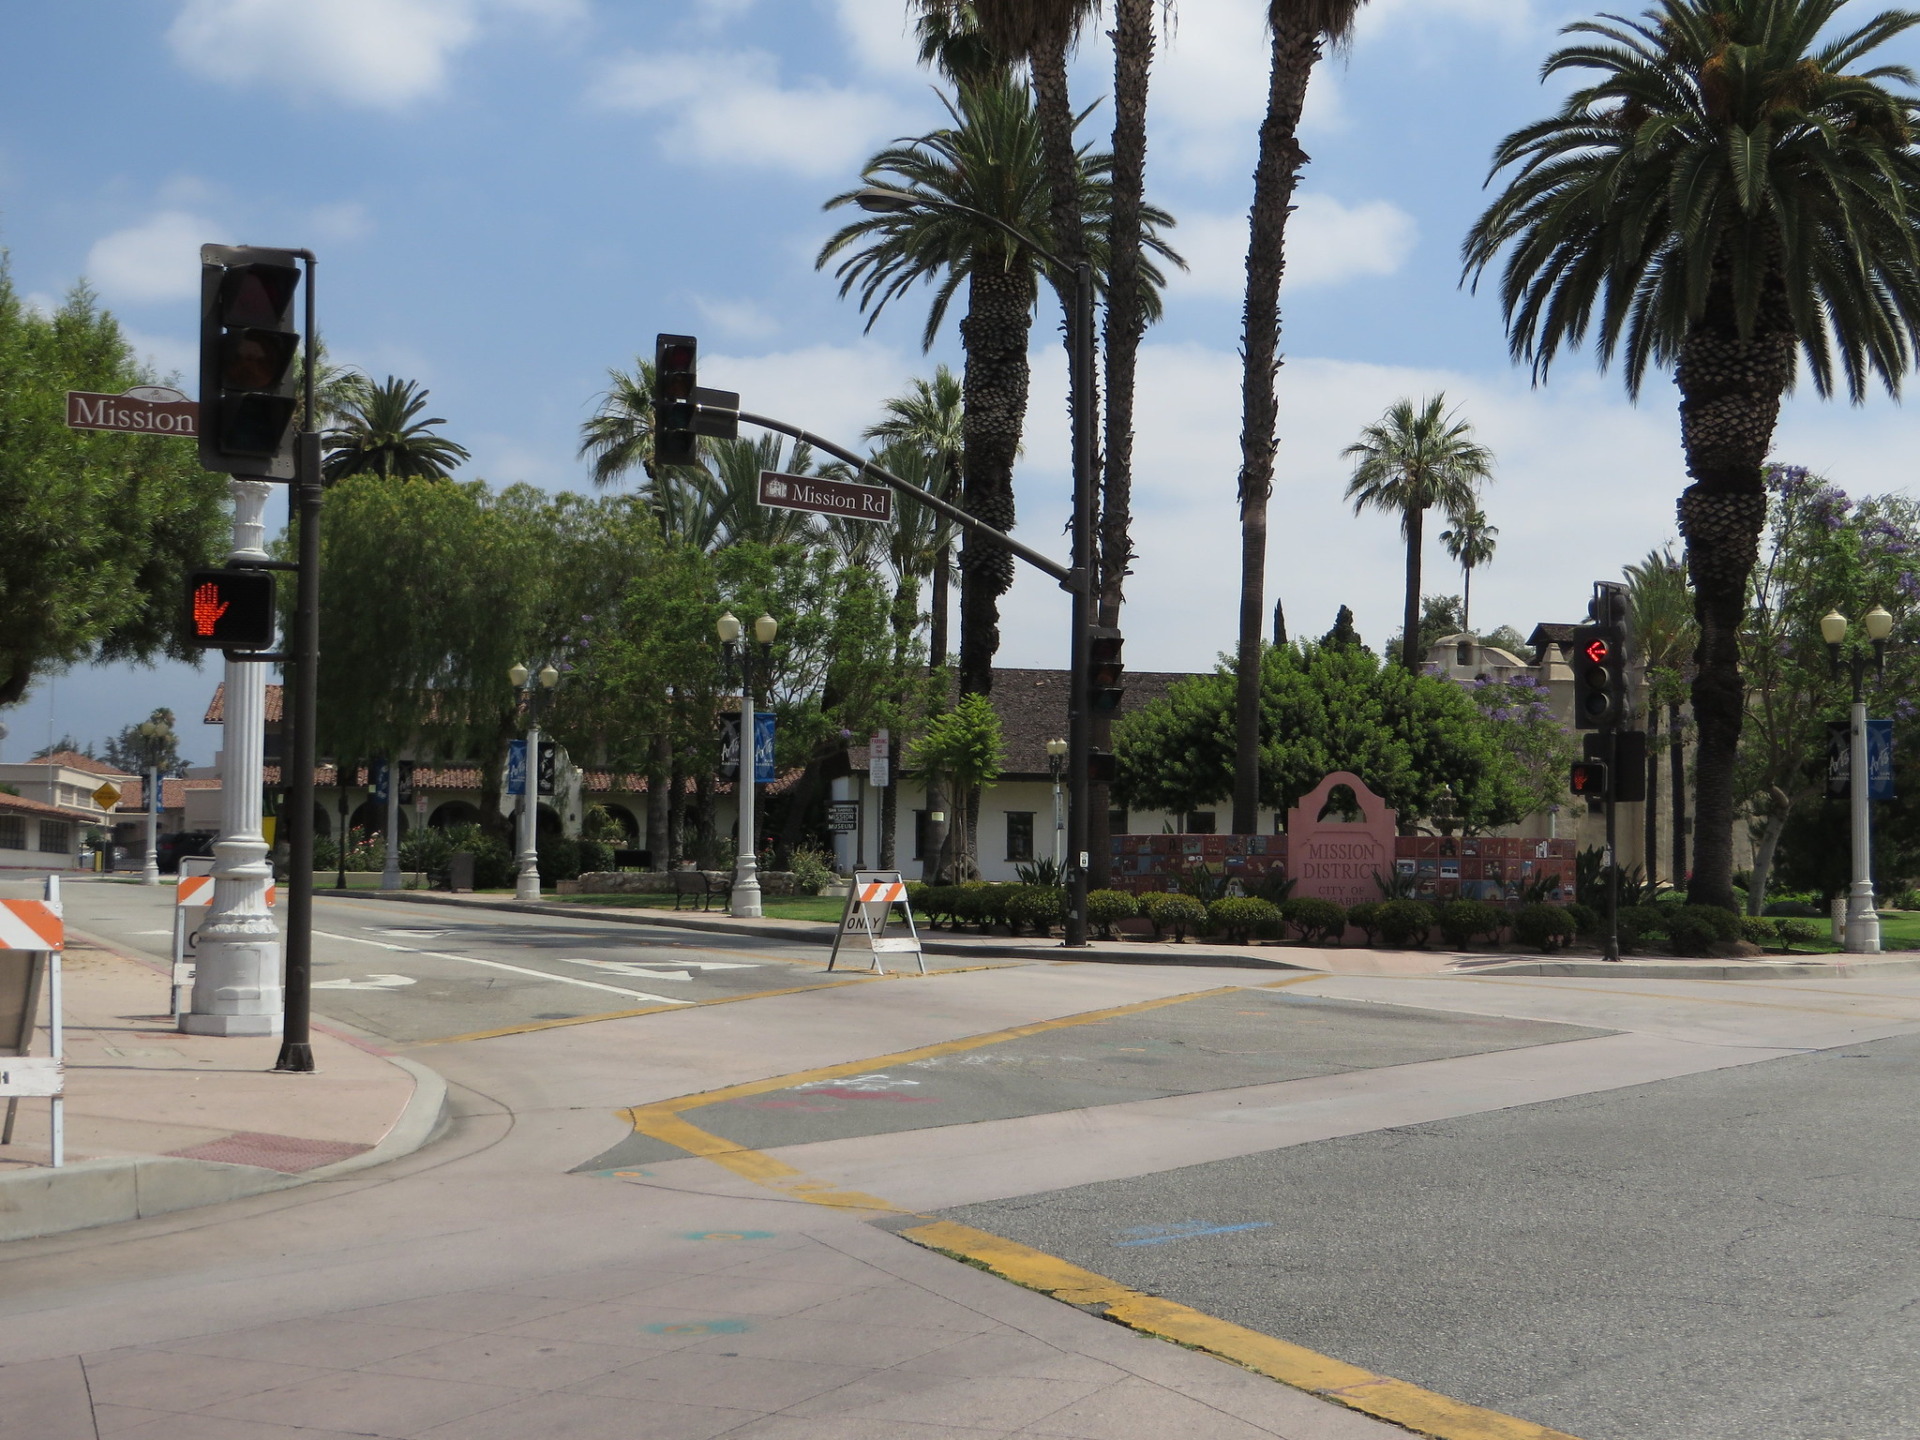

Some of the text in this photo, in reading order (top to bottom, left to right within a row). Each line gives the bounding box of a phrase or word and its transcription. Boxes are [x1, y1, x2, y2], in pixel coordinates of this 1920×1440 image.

[74, 397, 194, 432] Mission
[792, 483, 885, 513] Mission Rd
[1309, 844, 1375, 860] MISSION
[1303, 863, 1381, 879] DISTRICT
[1318, 886, 1365, 895] CITY OF
